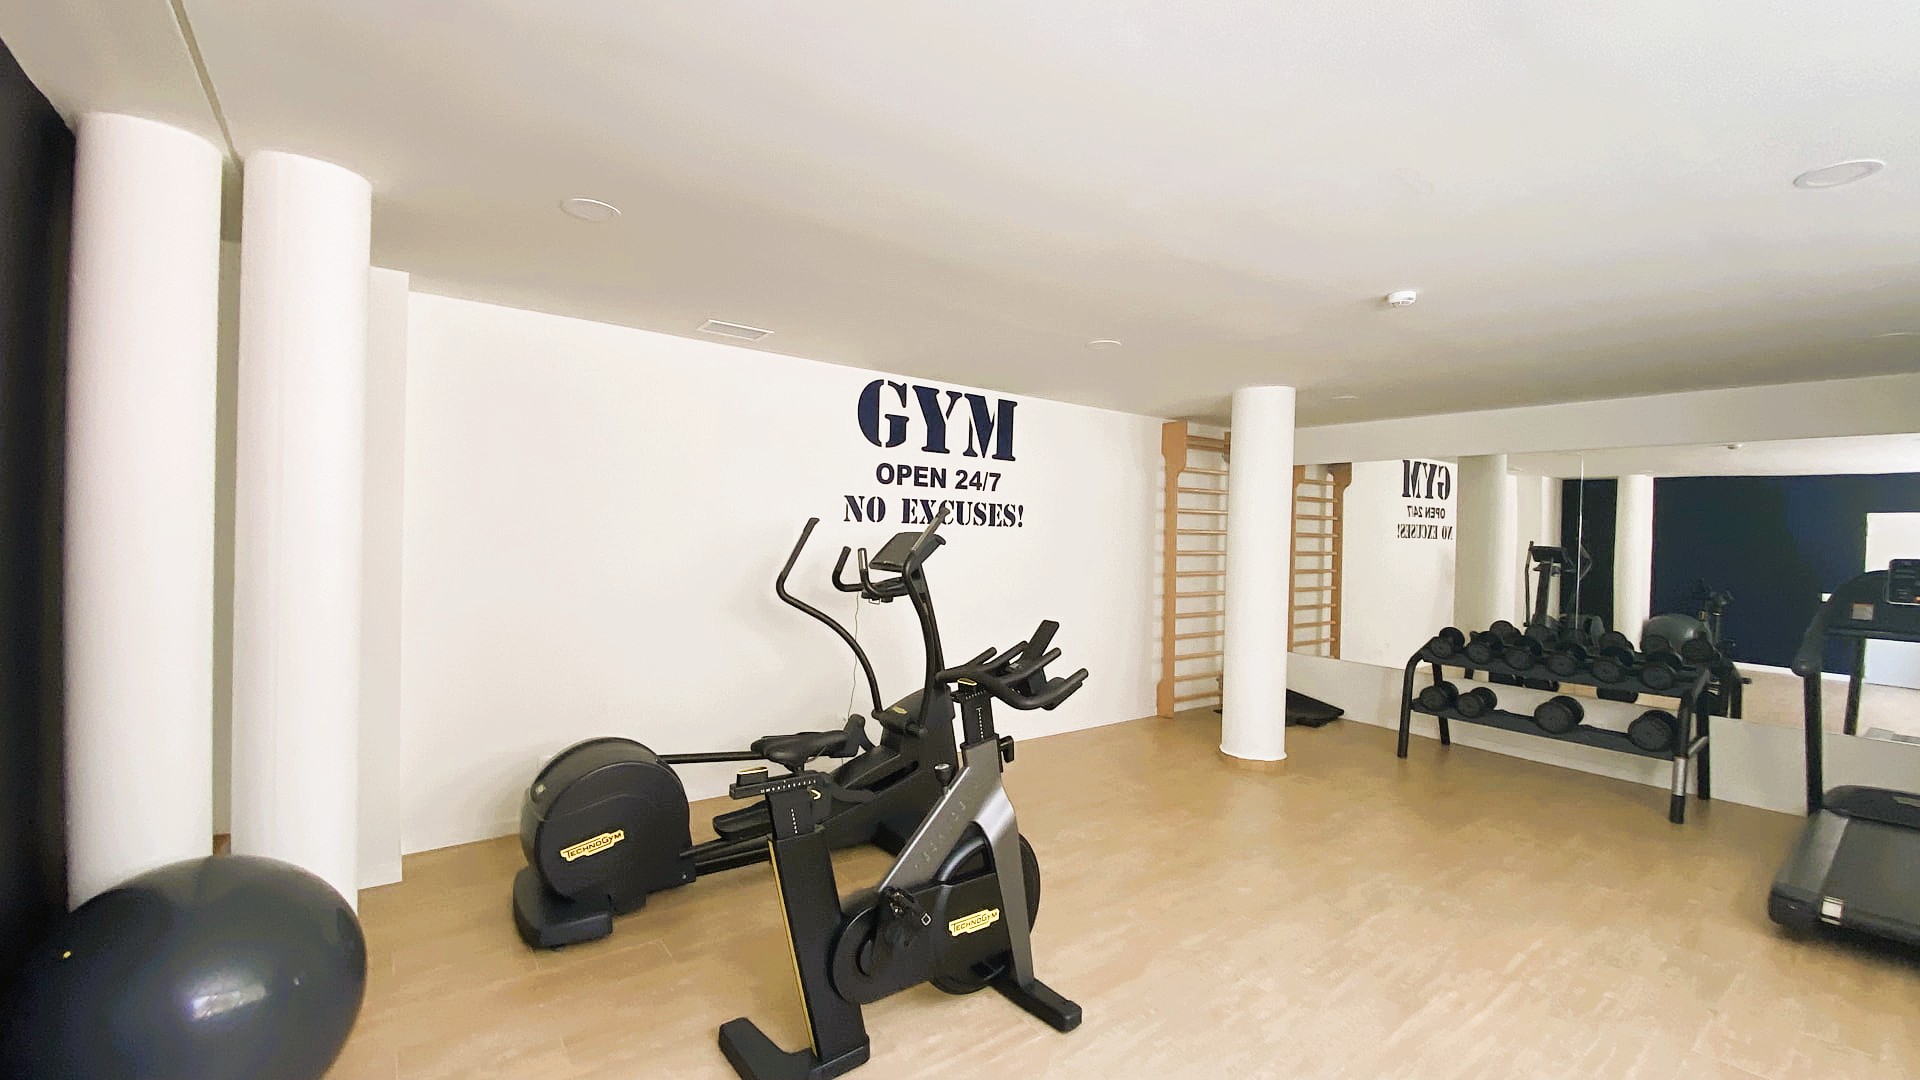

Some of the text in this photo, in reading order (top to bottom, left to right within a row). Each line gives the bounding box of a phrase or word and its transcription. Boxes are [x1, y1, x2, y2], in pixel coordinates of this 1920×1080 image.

[857, 378, 1018, 462] GYM
[876, 462, 1002, 492] OPEN 24/7
[843, 494, 886, 523] NO
